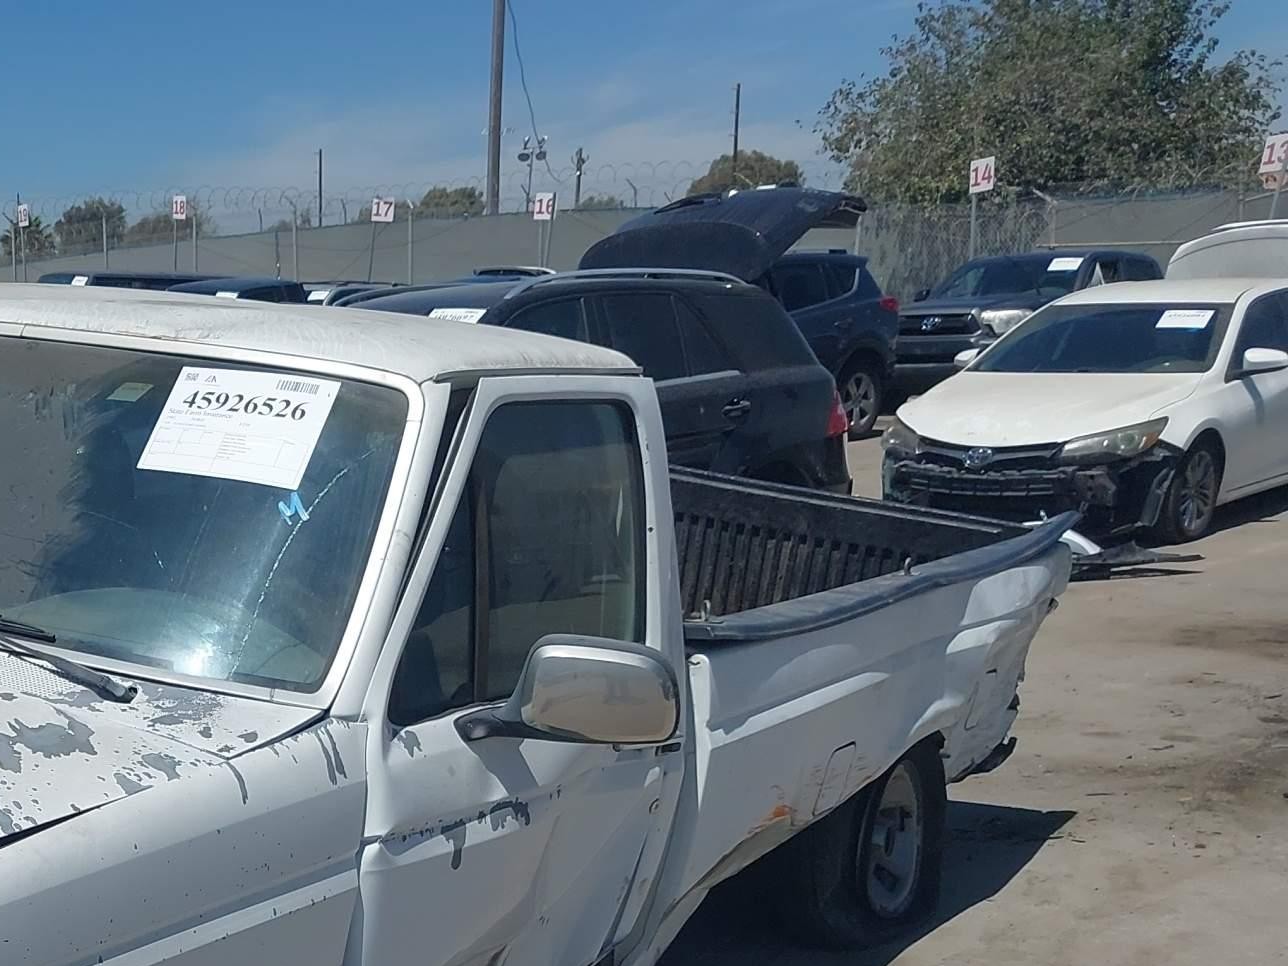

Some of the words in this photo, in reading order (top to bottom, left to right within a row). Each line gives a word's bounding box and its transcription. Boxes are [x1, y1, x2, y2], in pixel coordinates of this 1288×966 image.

[970, 163, 993, 187] 14
[18, 207, 28, 223] 19
[174, 200, 185, 215] 18
[373, 201, 393, 217] 17
[182, 390, 311, 422] 45926526
